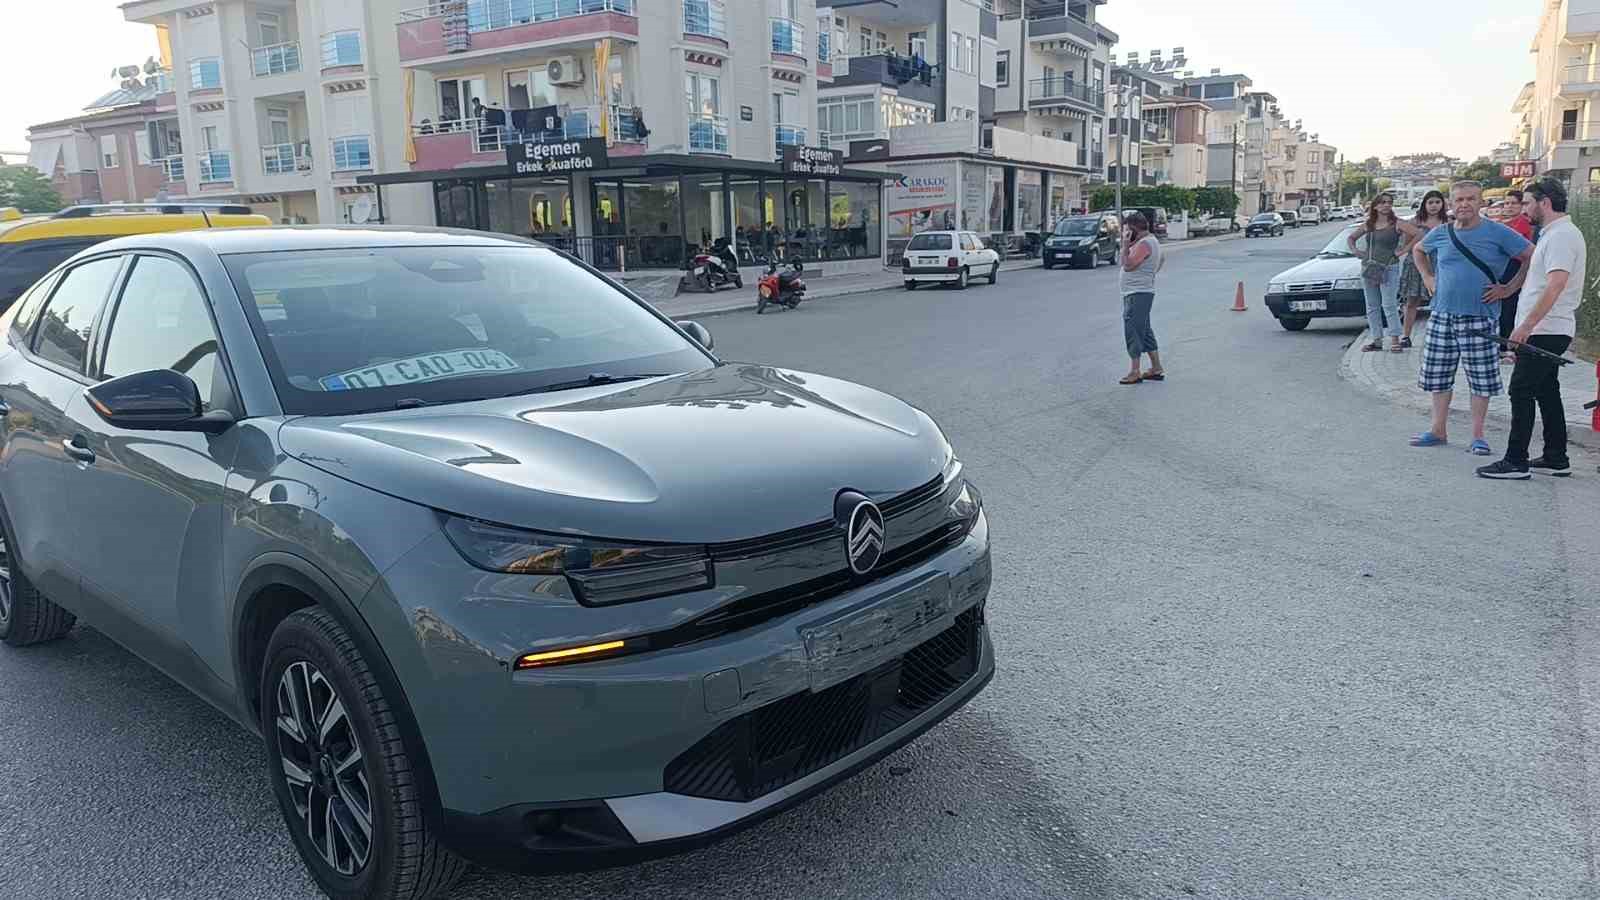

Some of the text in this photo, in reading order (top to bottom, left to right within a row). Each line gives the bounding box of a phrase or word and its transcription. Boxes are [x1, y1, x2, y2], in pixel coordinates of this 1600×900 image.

[524, 142, 581, 160] Egemen
[799, 145, 833, 163] Egemen
[516, 160, 544, 173] Erkek
[344, 368, 387, 389] 07
